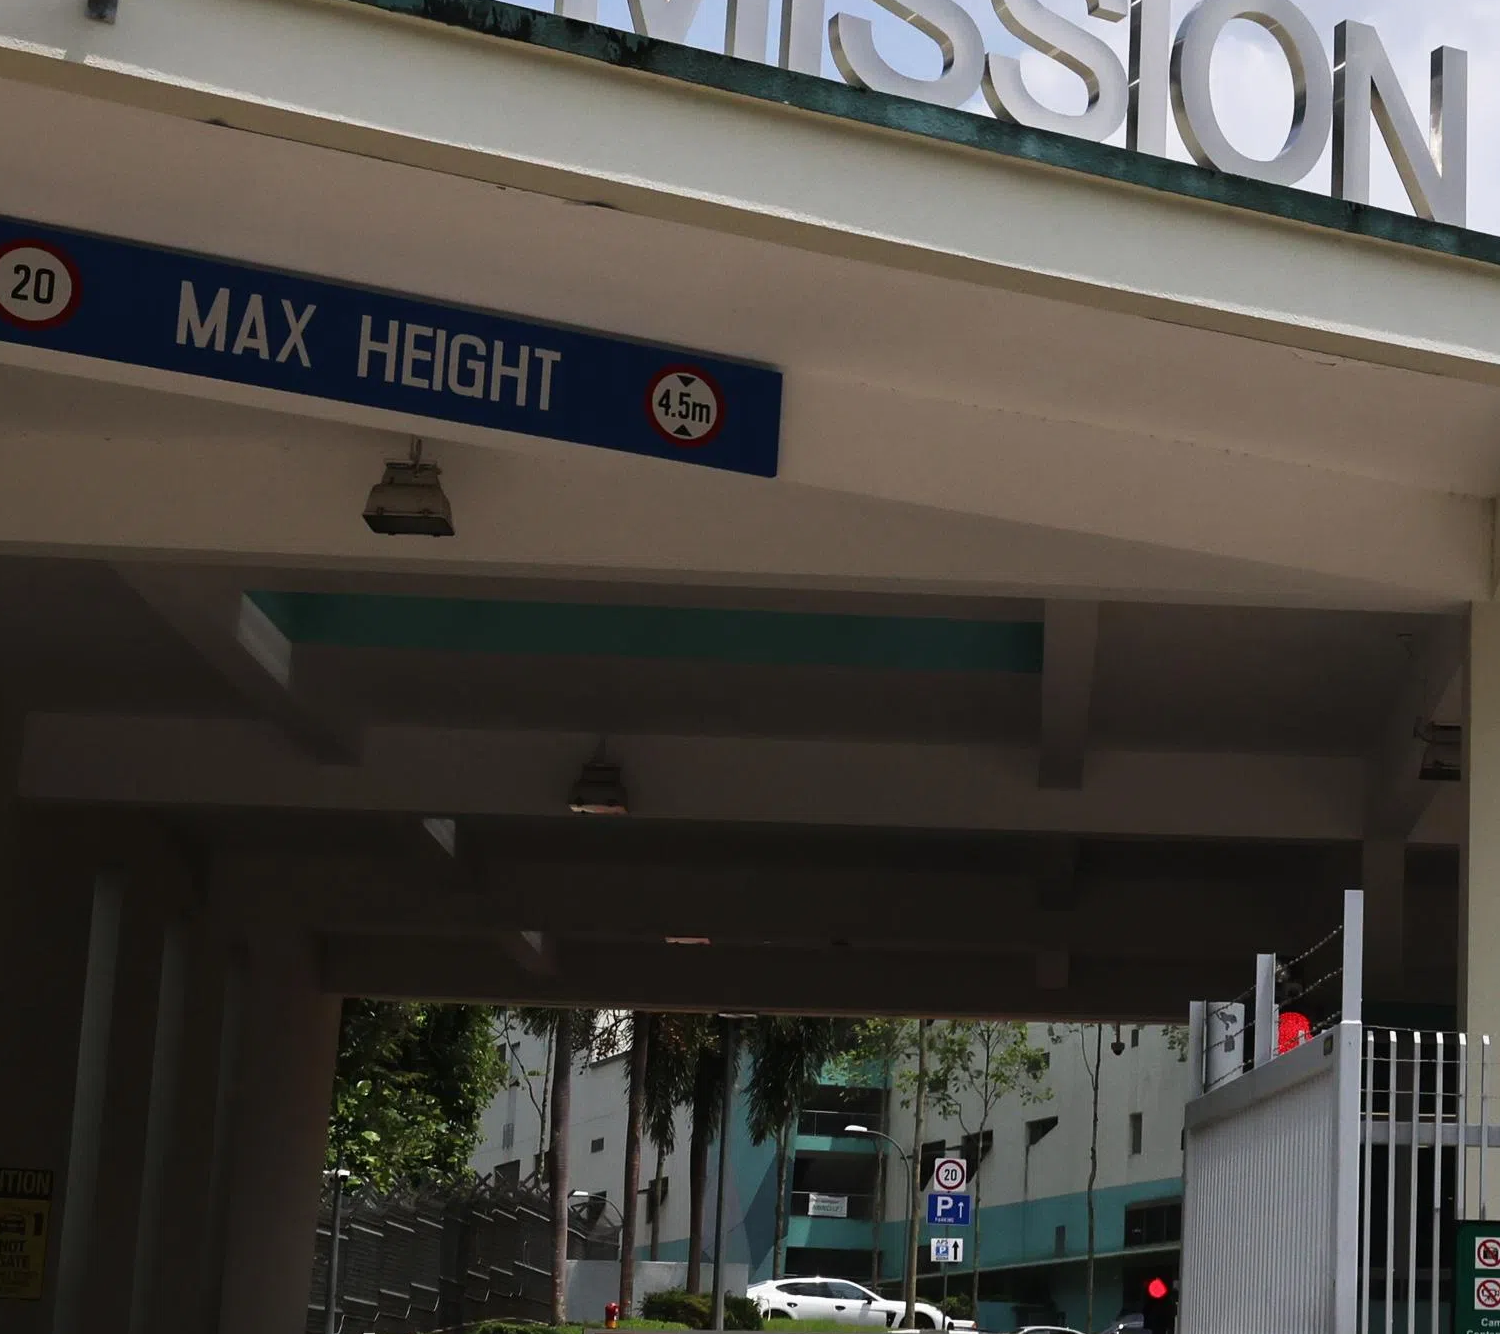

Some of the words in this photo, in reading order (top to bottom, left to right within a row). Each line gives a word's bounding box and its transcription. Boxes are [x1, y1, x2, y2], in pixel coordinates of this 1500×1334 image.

[11, 264, 56, 305] 20
[176, 279, 317, 368] MAX
[356, 314, 562, 411] HEIGHT
[657, 388, 711, 425] 4.5m
[944, 1168, 957, 1181] 20
[936, 1195, 954, 1217] P
[0, 1239, 26, 1252] NOT
